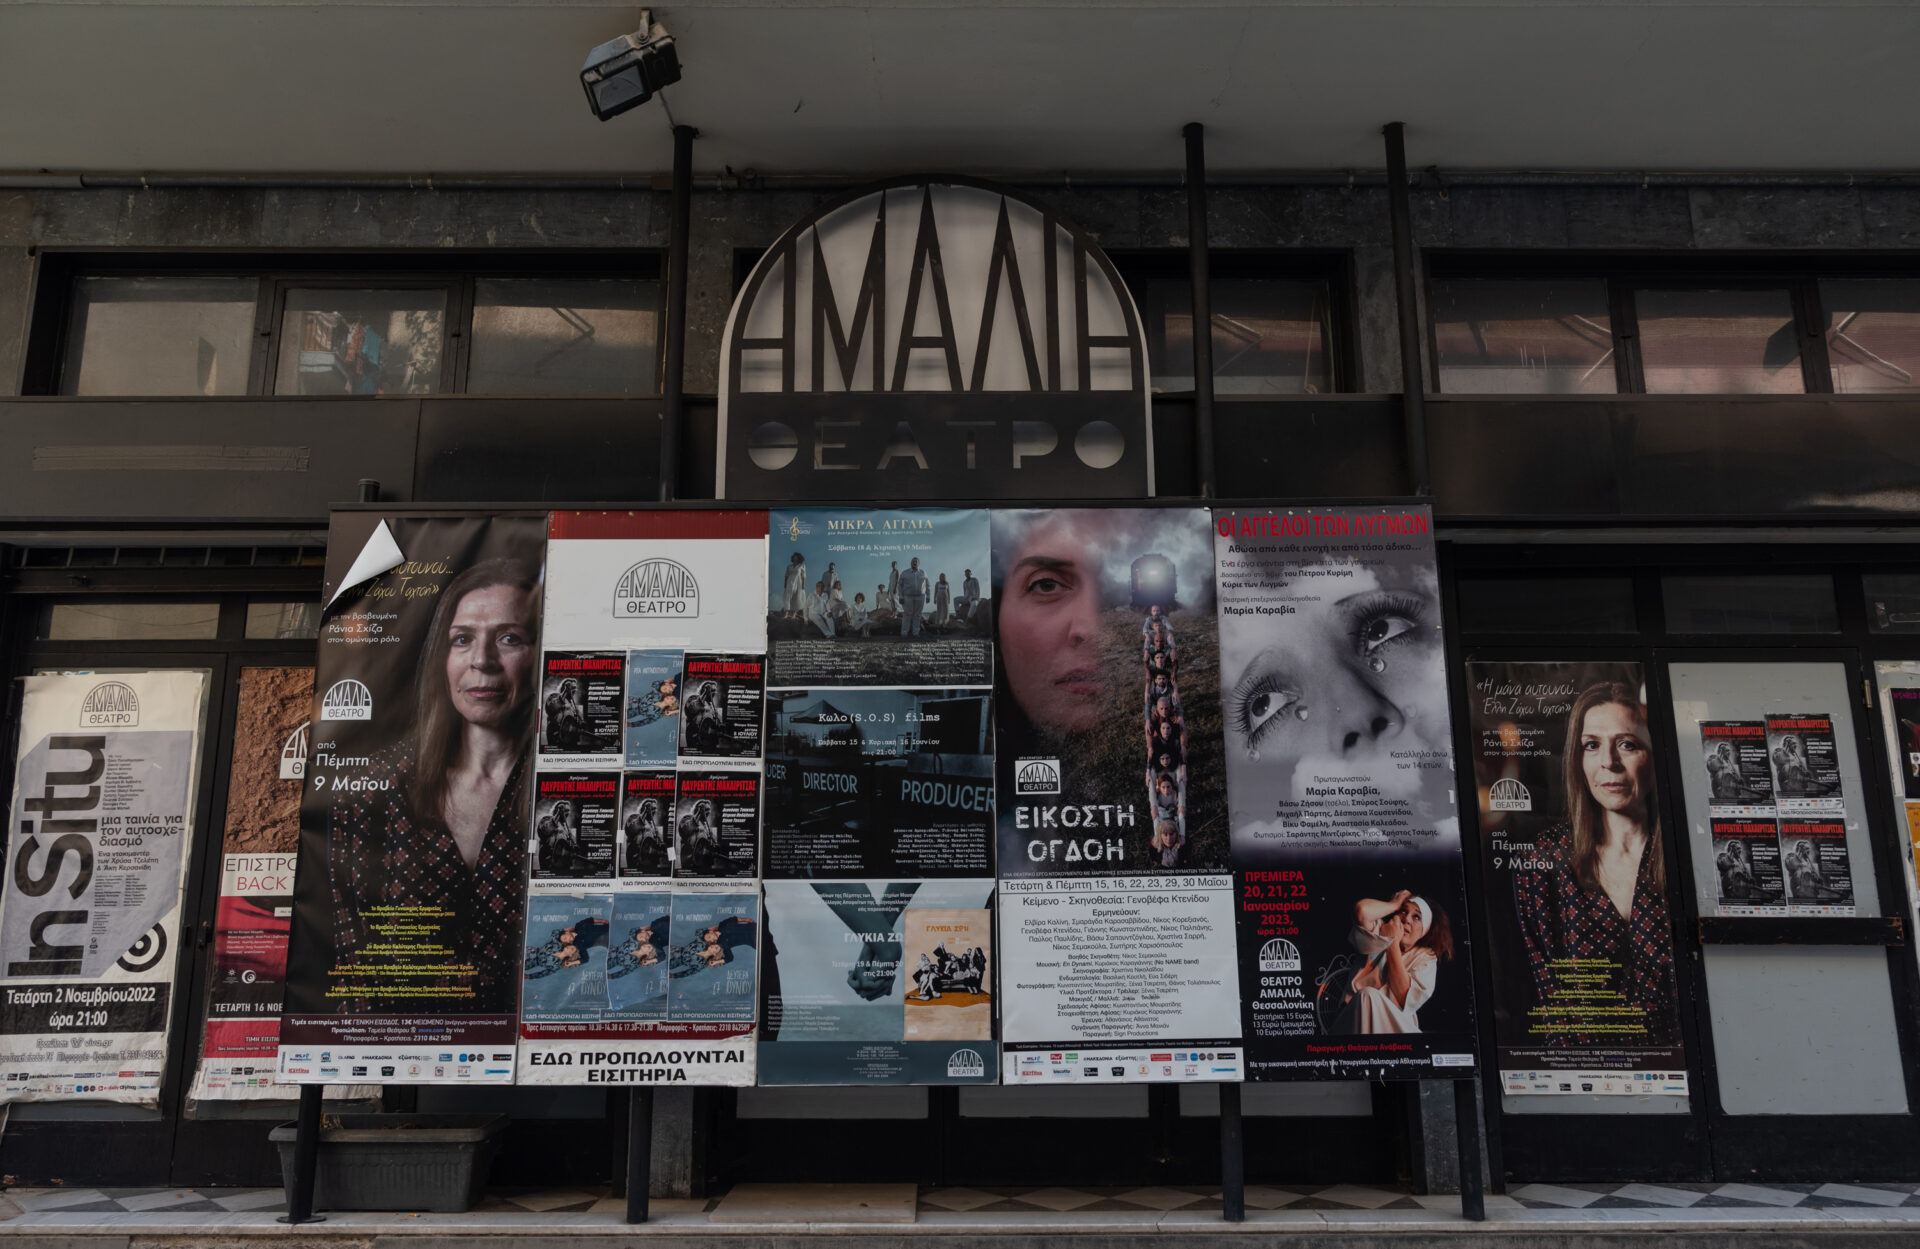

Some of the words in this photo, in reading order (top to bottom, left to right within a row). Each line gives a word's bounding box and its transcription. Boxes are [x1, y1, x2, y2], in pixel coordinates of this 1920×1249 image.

[729, 183, 1143, 391] ΑΜΑΛΙΑ
[747, 420, 1126, 470] ΘΕΑΤΡΟ
[827, 519, 874, 530] ΜΙΚΡΑ
[882, 519, 933, 529] ΑΓΓΛΙΑ
[1218, 516, 1236, 538] ΟΙ
[1241, 516, 1309, 537] ΑΓΓΕΛΟΙ
[1312, 515, 1349, 536] ΤΩΝ
[1354, 513, 1428, 535] ΛΥΓΜΩΝ
[627, 601, 687, 614] ΘΕΑΤΡΟ
[1224, 606, 1254, 616] Μαρία
[1255, 605, 1295, 616] Καραβία
[329, 623, 354, 633] Ράνια
[356, 622, 382, 634] Σχίζα
[89, 713, 131, 724] ΘΕΑΤΡΟ
[328, 708, 365, 717] ΘΕΑΤΡΟ
[904, 713, 940, 723] films
[317, 741, 336, 750] από
[1483, 738, 1508, 747] Ράνια
[316, 753, 369, 770] Πέμπτη
[314, 775, 326, 791] 9
[803, 772, 859, 794] DIRECTOR
[1023, 783, 1053, 791] ΘΕΑΤΡΟ
[900, 778, 995, 813] PRODUCER
[1306, 786, 1336, 797] Μαρία
[1338, 785, 1380, 797] Καραβία,
[1495, 801, 1526, 809] ΘΕΑΤΡΟ
[14, 735, 106, 900] Situ
[101, 816, 122, 826] μια
[126, 814, 161, 824] ταινία
[164, 814, 184, 826] για
[1015, 804, 1135, 829] ΕΙΚΟΣΤΗ
[101, 827, 122, 836] τον
[1491, 831, 1507, 839] από
[100, 836, 143, 848] διασμό
[1491, 840, 1534, 853] Πέμπτη
[1027, 838, 1124, 862] ΟΓΔΟΗ
[1493, 857, 1503, 870] 9
[1245, 871, 1304, 882] ΠΡΕΜΙΕΡΑ
[236, 875, 288, 891] BACK
[1004, 881, 1043, 892] Τετάρτη
[1046, 881, 1053, 890] &
[1056, 880, 1092, 891] Πέμπτη
[1096, 879, 1110, 890] 15,
[1114, 879, 1127, 889] 16,
[1130, 878, 1145, 888] 22,
[1147, 878, 1162, 888] 23,
[1165, 878, 1180, 888] 29,
[1183, 877, 1195, 887] 30
[1244, 885, 1264, 899] 20,
[1267, 885, 1287, 899] 21,
[1290, 884, 1308, 897] 22
[1023, 896, 1059, 907] Κείμενο
[1069, 895, 1125, 907] Σκηνοθεσία:
[1127, 895, 1170, 905] Γενοβέφα
[1171, 894, 1210, 903] Κτενίδου
[1243, 899, 1310, 914] Ιανουαρίου
[1260, 914, 1294, 926] 2023,
[1276, 927, 1299, 936] 21:00
[8, 910, 89, 976] In
[1265, 961, 1296, 969] ΘΕΑΤΡΟ
[1260, 976, 1303, 987] ΘΕΑΤΡΟ
[7, 989, 53, 1007] Τετάρτη
[55, 988, 63, 1004] 2
[1259, 988, 1305, 999] ΑΜΑΛΙΑ,
[215, 1003, 251, 1012] ΤΕΤΑΡΤΗ
[255, 1003, 264, 1011] 16
[1251, 1000, 1315, 1011] Θεσσαλονίκη
[49, 1011, 75, 1030] ώρα
[76, 1010, 109, 1027] 21:00
[530, 1051, 573, 1066] ΕΔΩ
[579, 1050, 745, 1065] ΠΡΟΠΩΛΟΥΝΤΑΙ
[587, 1069, 687, 1083] ΕΙΣΙΤΗΡΙΑ
